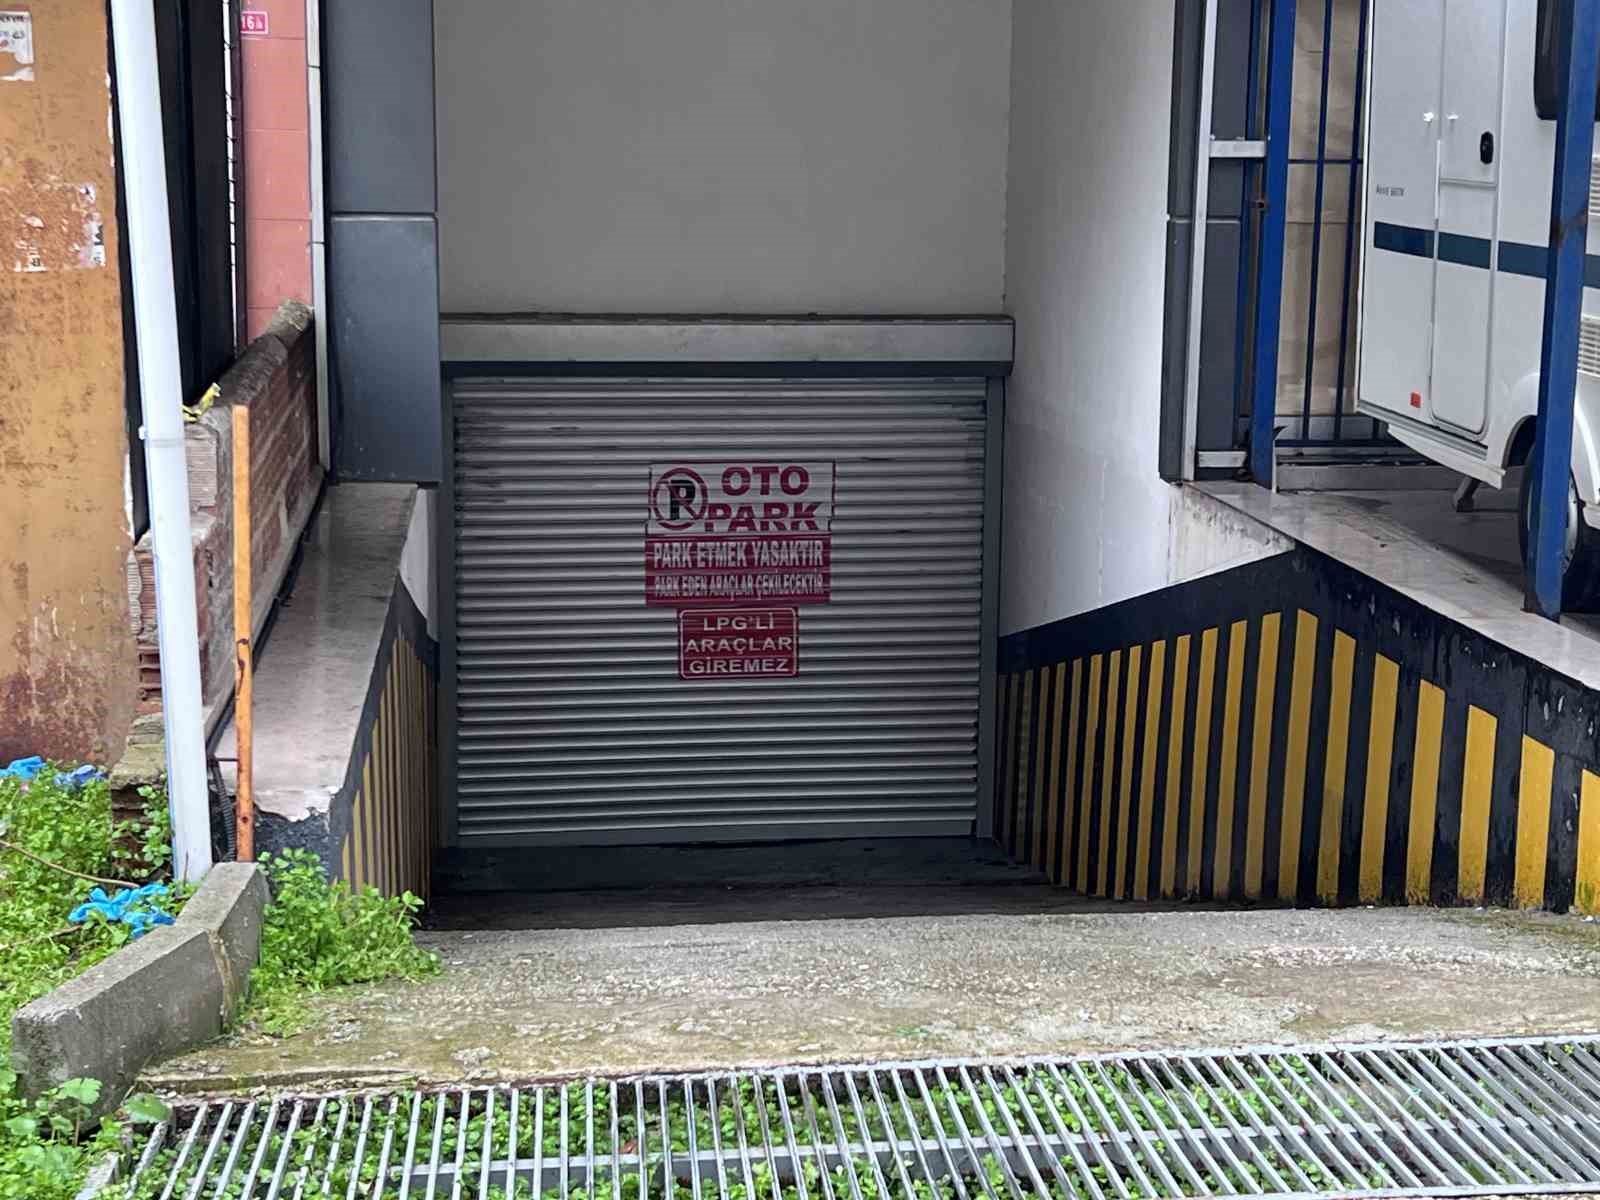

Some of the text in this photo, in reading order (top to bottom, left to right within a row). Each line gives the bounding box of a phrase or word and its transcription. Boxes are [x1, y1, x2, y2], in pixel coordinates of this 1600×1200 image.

[721, 466, 809, 496] OTO
[705, 501, 823, 532] PARK
[654, 540, 823, 568] PARK ETMEK YASAKTIR
[655, 576, 680, 597] PARK
[682, 575, 708, 597] EDEN
[703, 613, 774, 631] LPG'Lİ
[685, 637, 792, 654] ARAÇLAR
[689, 656, 789, 674] GİREMEZ
